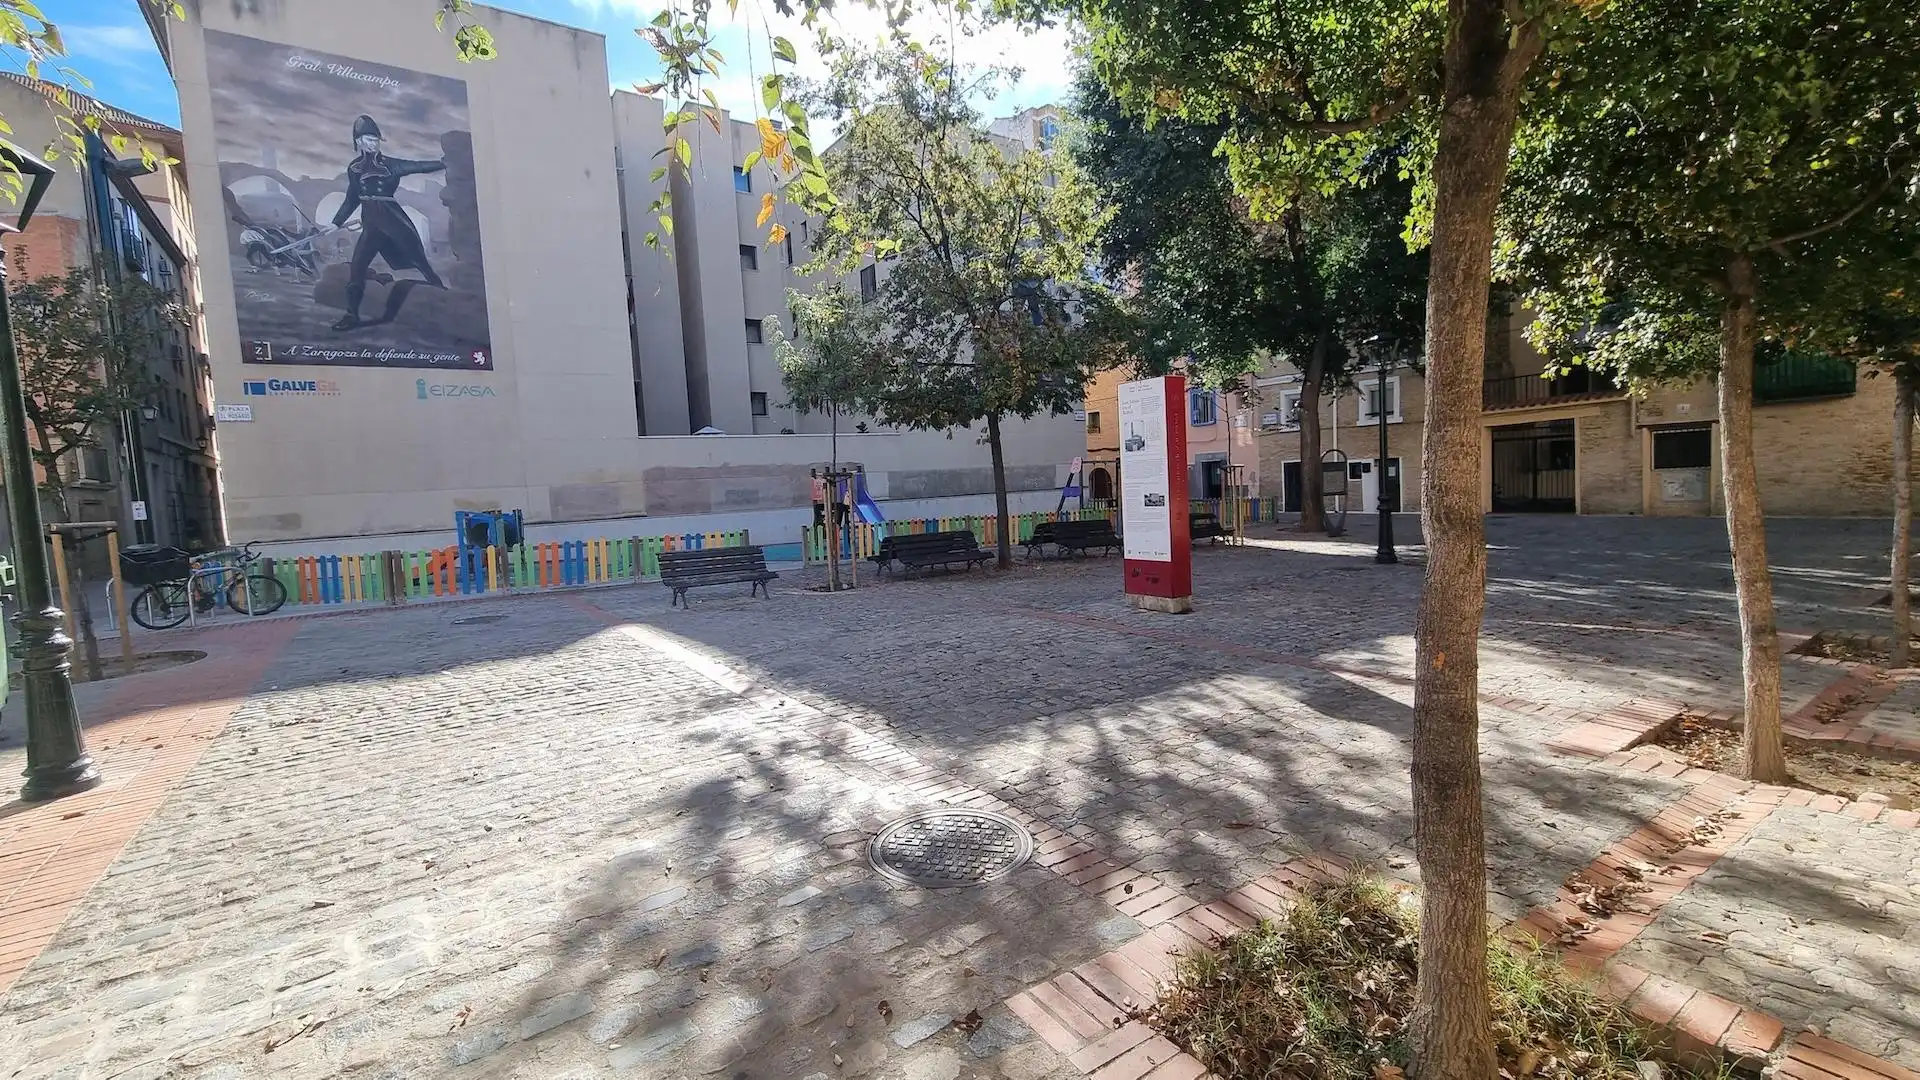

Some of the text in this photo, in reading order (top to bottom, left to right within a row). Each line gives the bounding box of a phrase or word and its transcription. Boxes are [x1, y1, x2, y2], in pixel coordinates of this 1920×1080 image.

[286, 55, 401, 88] Gral. Villacampa
[281, 345, 298, 356] A
[302, 345, 359, 361] Zaragoza
[361, 348, 372, 358] la
[375, 348, 416, 362] defiende
[431, 354, 461, 364] gente
[430, 384, 496, 398] EIZASA
